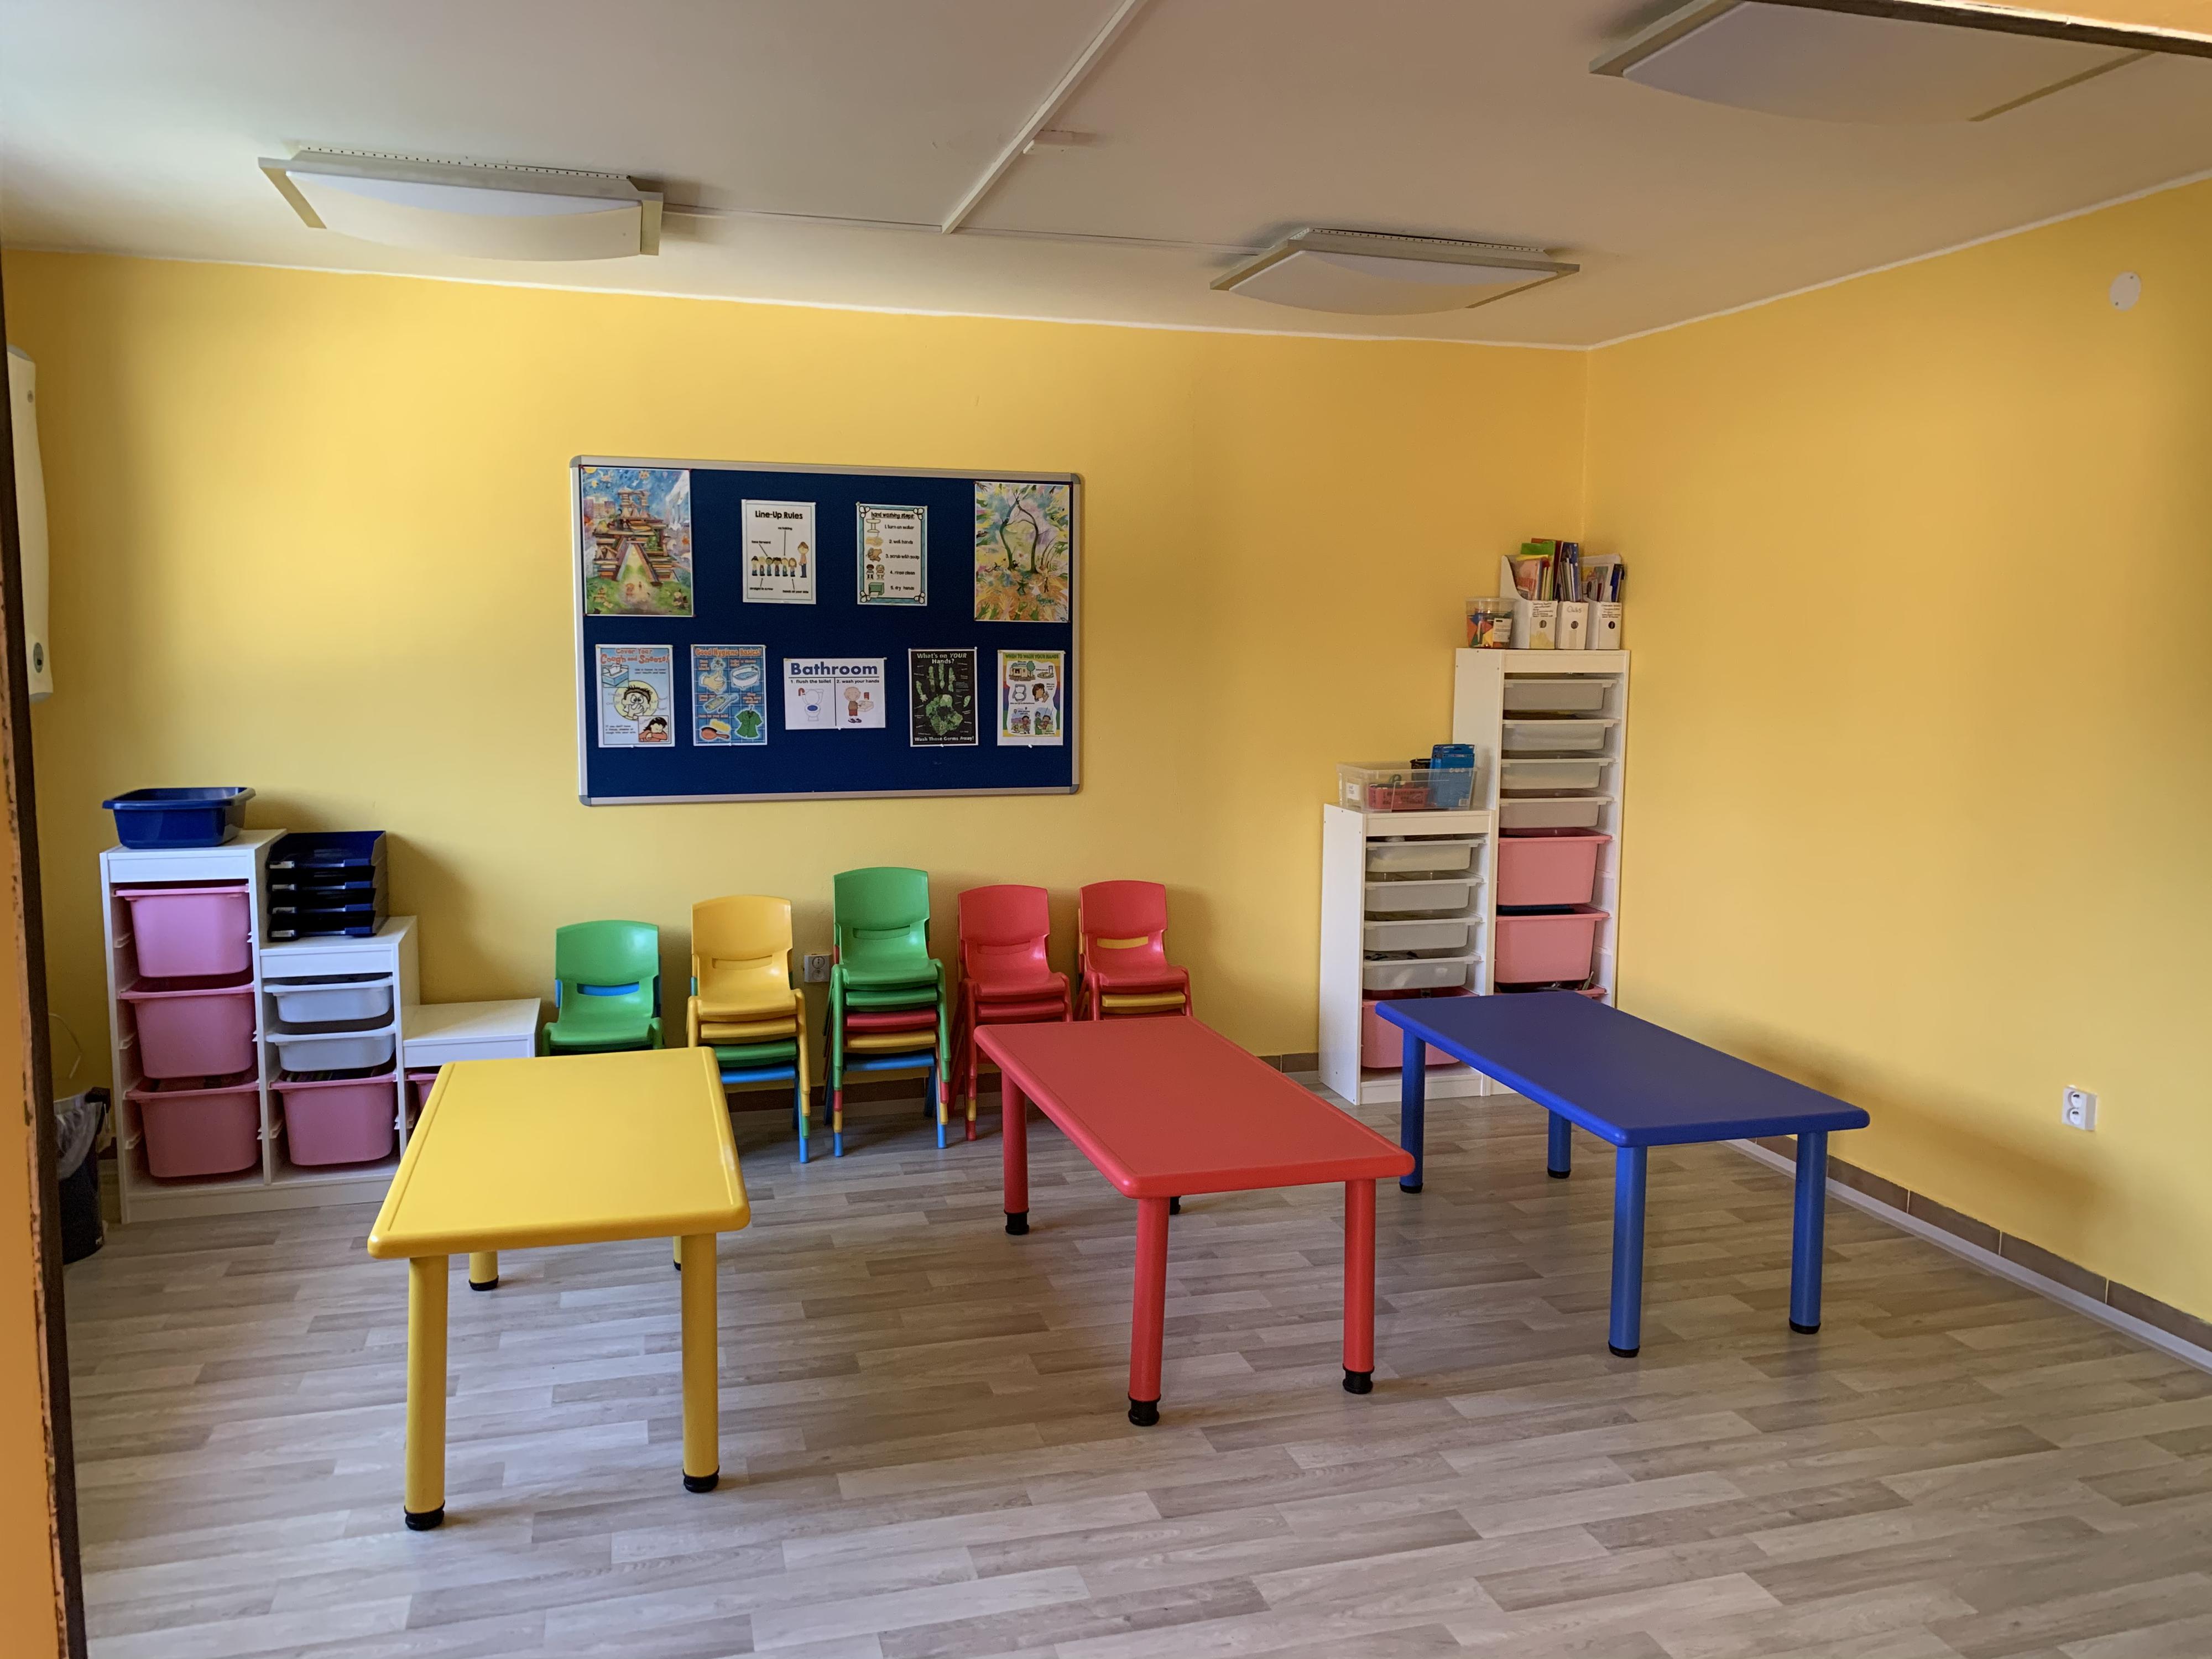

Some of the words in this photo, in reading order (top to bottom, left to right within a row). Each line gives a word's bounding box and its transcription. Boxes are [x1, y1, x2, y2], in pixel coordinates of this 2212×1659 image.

[755, 510, 782, 519] Line-Up
[601, 654, 627, 665] Cough
[791, 661, 878, 675] Bathroom
